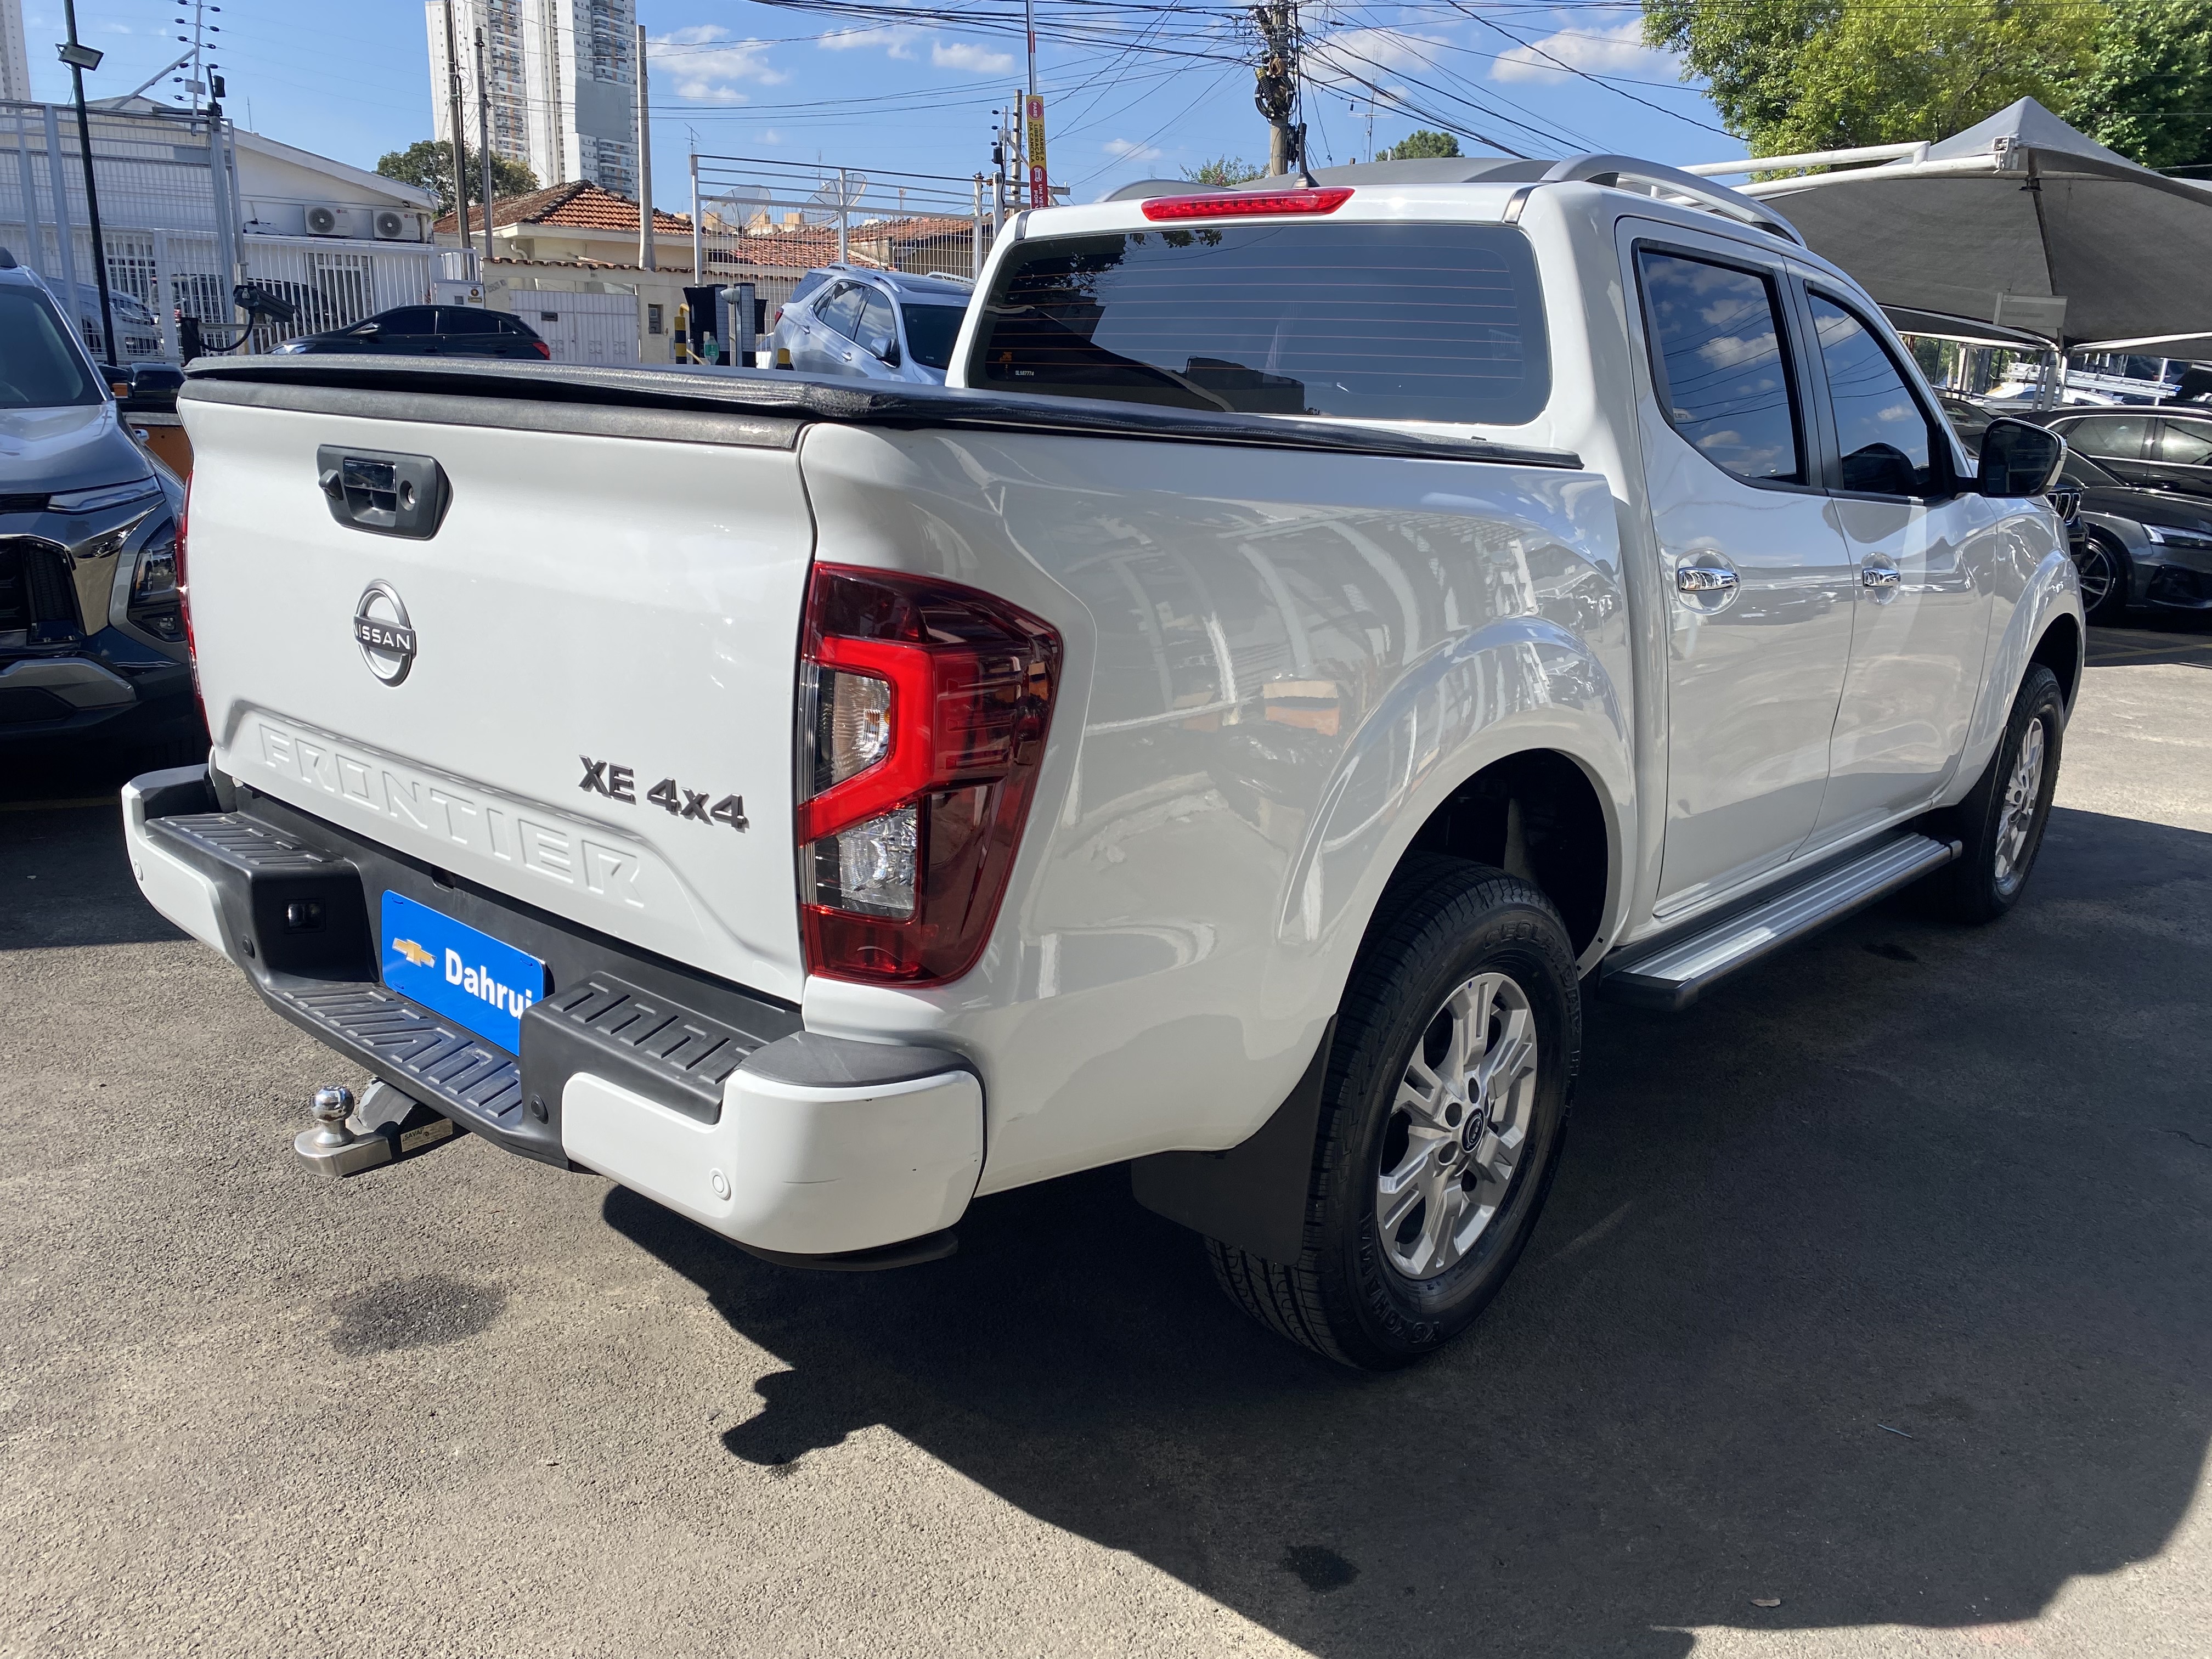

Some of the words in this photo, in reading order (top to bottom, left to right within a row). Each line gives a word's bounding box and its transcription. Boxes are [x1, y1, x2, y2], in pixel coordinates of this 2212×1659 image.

[1029, 122, 1033, 131] DA
[1038, 184, 1043, 194] UM
[353, 623, 410, 650] NISSAN
[578, 754, 636, 805] XE
[258, 724, 646, 909] FRONTIER
